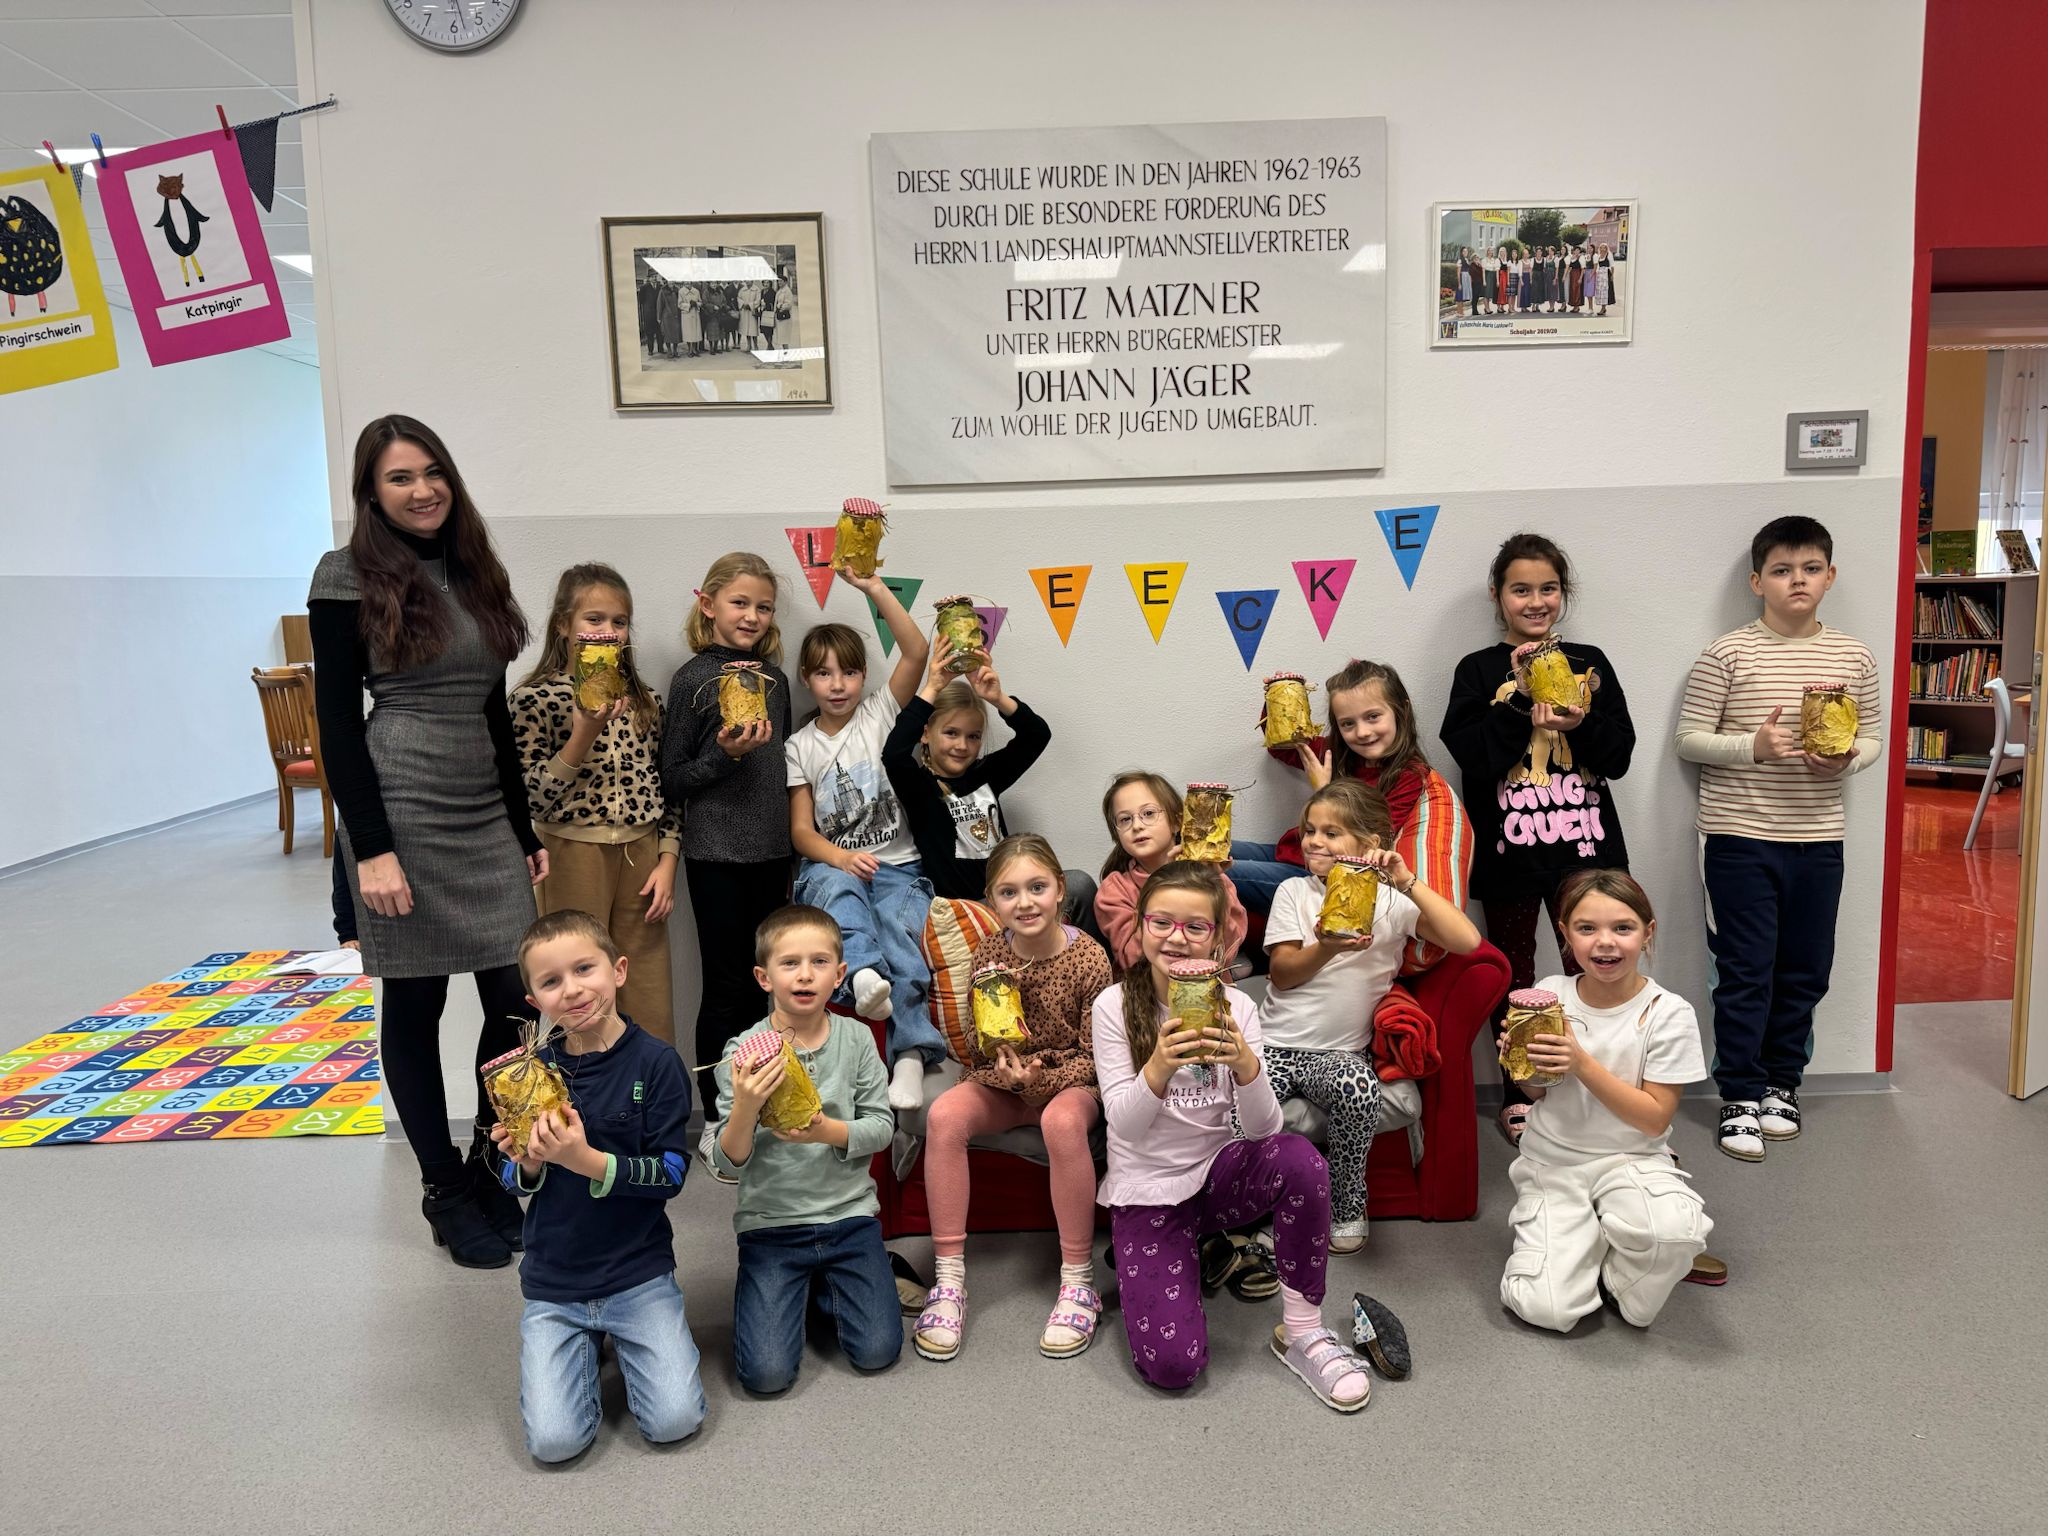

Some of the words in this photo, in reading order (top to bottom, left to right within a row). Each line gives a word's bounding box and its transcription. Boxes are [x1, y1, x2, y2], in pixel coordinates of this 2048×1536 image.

[424, 13, 432, 27] 7
[450, 20, 458, 33] 6
[474, 12, 483, 26] 5
[898, 170, 951, 193] DIESE
[960, 167, 1031, 191] SCHULE
[1038, 164, 1108, 189] WURDE
[1116, 163, 1135, 187] IN
[1143, 162, 1181, 186] DEN
[1187, 160, 1257, 190] JAHREN
[1264, 156, 1361, 182] 1962-1963
[934, 205, 997, 228] DURCH
[1005, 203, 1034, 226] DIE
[1043, 199, 1158, 225] BESONDERE
[1165, 194, 1281, 220] FÖRDERUNG
[1288, 193, 1327, 217] DES
[914, 240, 977, 265] HERRN
[981, 240, 992, 263] 1.
[996, 228, 1350, 263] LANDESHAUPTMANNSTELLVERTRETER
[185, 296, 242, 319] Katpingir
[1006, 286, 1088, 322] FRITZ
[1105, 280, 1260, 319] MATZNER
[0, 322, 82, 347] Pingirschwein
[986, 332, 1049, 356] UNTER
[1057, 330, 1121, 353] HERRN
[1128, 323, 1282, 352] BÜRGERMEISTER
[1016, 367, 1135, 412] JOHANN
[1150, 363, 1251, 407] JÄGER
[951, 416, 993, 438] ZUM
[1001, 413, 1067, 437] WOHLE
[1076, 412, 1111, 435] DER
[1117, 408, 1198, 440] JUGEND
[1207, 404, 1317, 431] UMGEBAUT.
[1395, 514, 1422, 550] E
[807, 532, 832, 567] L
[1048, 573, 1075, 609] E
[1143, 570, 1169, 605] E
[1310, 567, 1338, 602] K
[1233, 597, 1262, 632] C
[171, 968, 210, 981] 92
[213, 967, 251, 980] 82
[140, 983, 180, 996] 93
[183, 982, 222, 995] 83
[226, 980, 266, 994] 73
[270, 978, 306, 991] 63
[313, 977, 349, 990] 53
[150, 999, 191, 1012] 84
[195, 997, 238, 1010] 74
[240, 996, 280, 1008] 64
[284, 994, 324, 1007] 54
[330, 992, 365, 1005] 44
[104, 1000, 147, 1014] 94
[115, 1016, 158, 1029] 85
[161, 1014, 207, 1027] 75
[208, 1012, 250, 1025] 65
[255, 1010, 296, 1024] 55
[302, 1008, 338, 1022] 45
[68, 1017, 112, 1031] 95
[124, 1032, 172, 1047] 76
[173, 1030, 217, 1045] 66
[222, 1029, 267, 1043] 56
[271, 1027, 311, 1042] 46
[319, 1025, 360, 1039] 36
[26, 1036, 75, 1050] 96
[75, 1034, 122, 1049] 86
[190, 1049, 233, 1064] 57
[241, 1046, 278, 1061] 47
[291, 1044, 332, 1059] 37
[342, 1042, 378, 1057] 27
[38, 1054, 83, 1069] 87
[89, 1052, 135, 1068] 77
[139, 1050, 182, 1065] 67
[147, 1070, 197, 1087] 58
[200, 1068, 245, 1085] 48
[253, 1065, 300, 1082] 38
[306, 1063, 353, 1080] 28
[40, 1073, 95, 1091] 78
[93, 1072, 144, 1089] 68
[216, 1088, 266, 1106] 39
[272, 1086, 321, 1105] 29
[328, 1085, 373, 1103] 19
[1169, 1087, 1203, 1097] MILE
[49, 1096, 100, 1114] 69
[104, 1094, 158, 1112] 59
[161, 1091, 207, 1109] 49
[1165, 1096, 1217, 1108] ERYDAY
[115, 1118, 172, 1137] 50
[174, 1115, 224, 1135] 40
[233, 1113, 285, 1133] 30
[292, 1111, 343, 1132] 20
[0, 1121, 59, 1142] 70
[56, 1120, 113, 1140] 60
